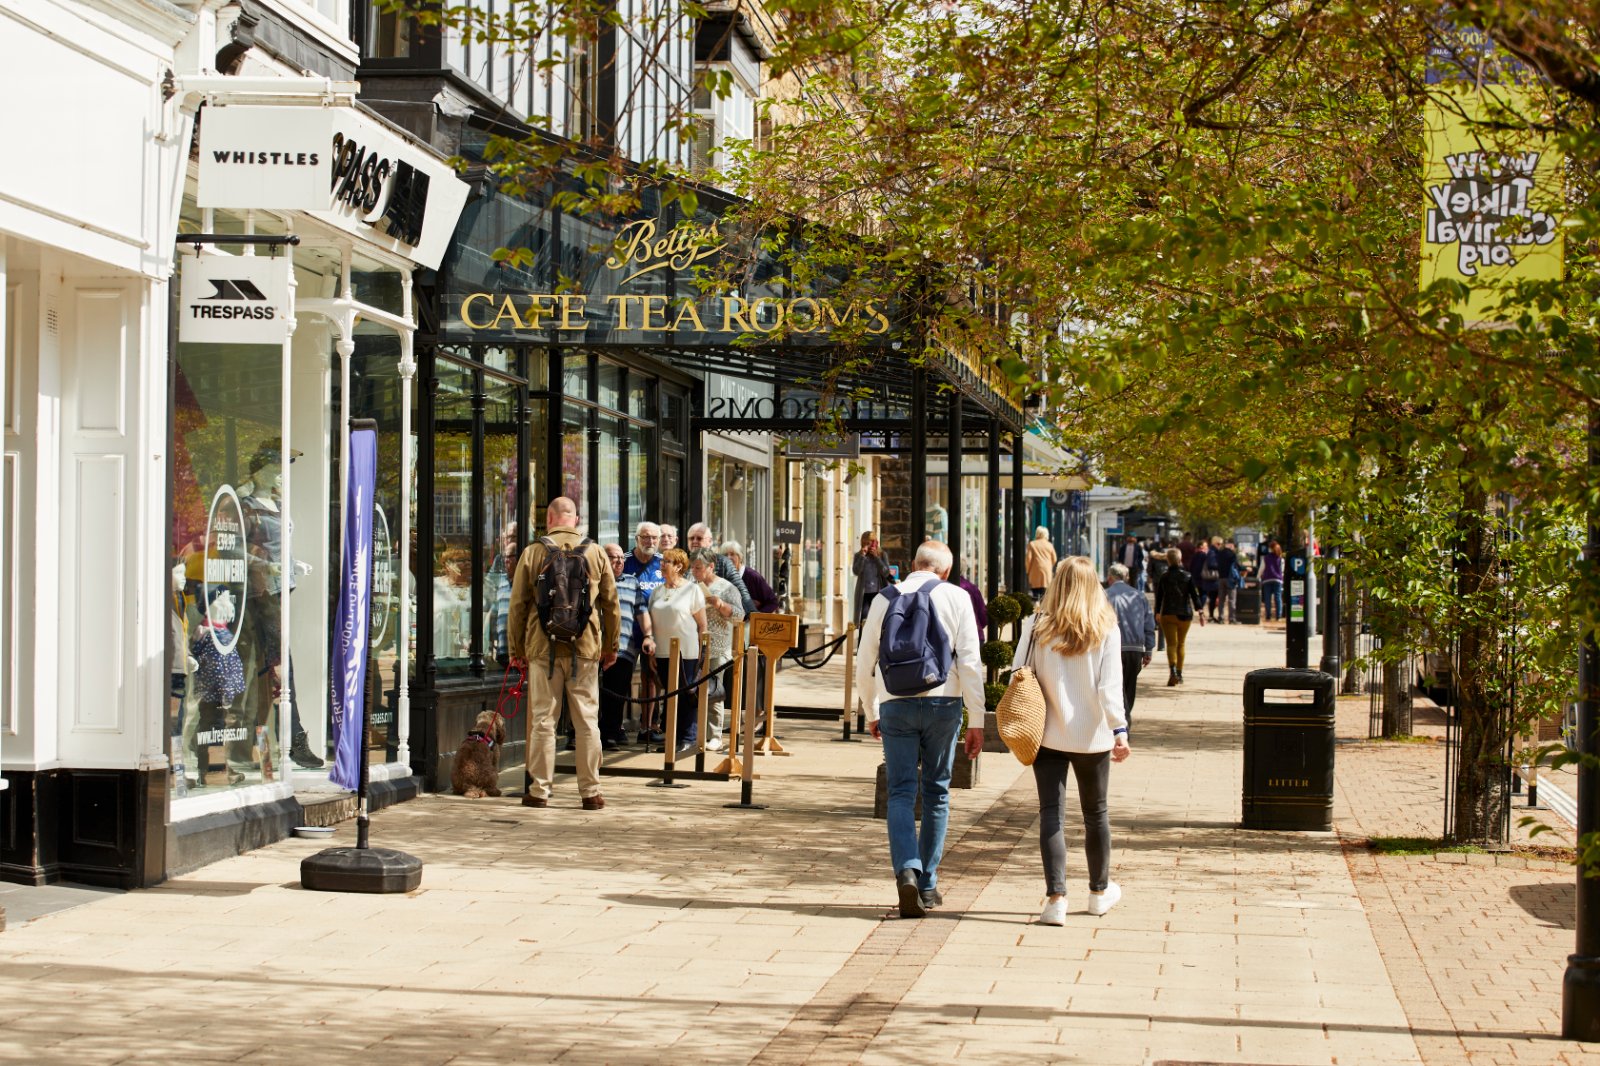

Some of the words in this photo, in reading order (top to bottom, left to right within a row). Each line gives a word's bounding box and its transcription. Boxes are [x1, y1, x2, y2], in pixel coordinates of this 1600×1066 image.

[213, 150, 319, 166] WHISTLES
[190, 304, 275, 320] TRESPASS
[460, 292, 590, 330] CAFE
[607, 294, 709, 332] TEA
[718, 296, 890, 334] ROOMS
[207, 558, 245, 582] RAINWEAR
[1294, 558, 1304, 572] P
[197, 726, 248, 746] www.trespass.com
[1268, 778, 1309, 787] LITTER
